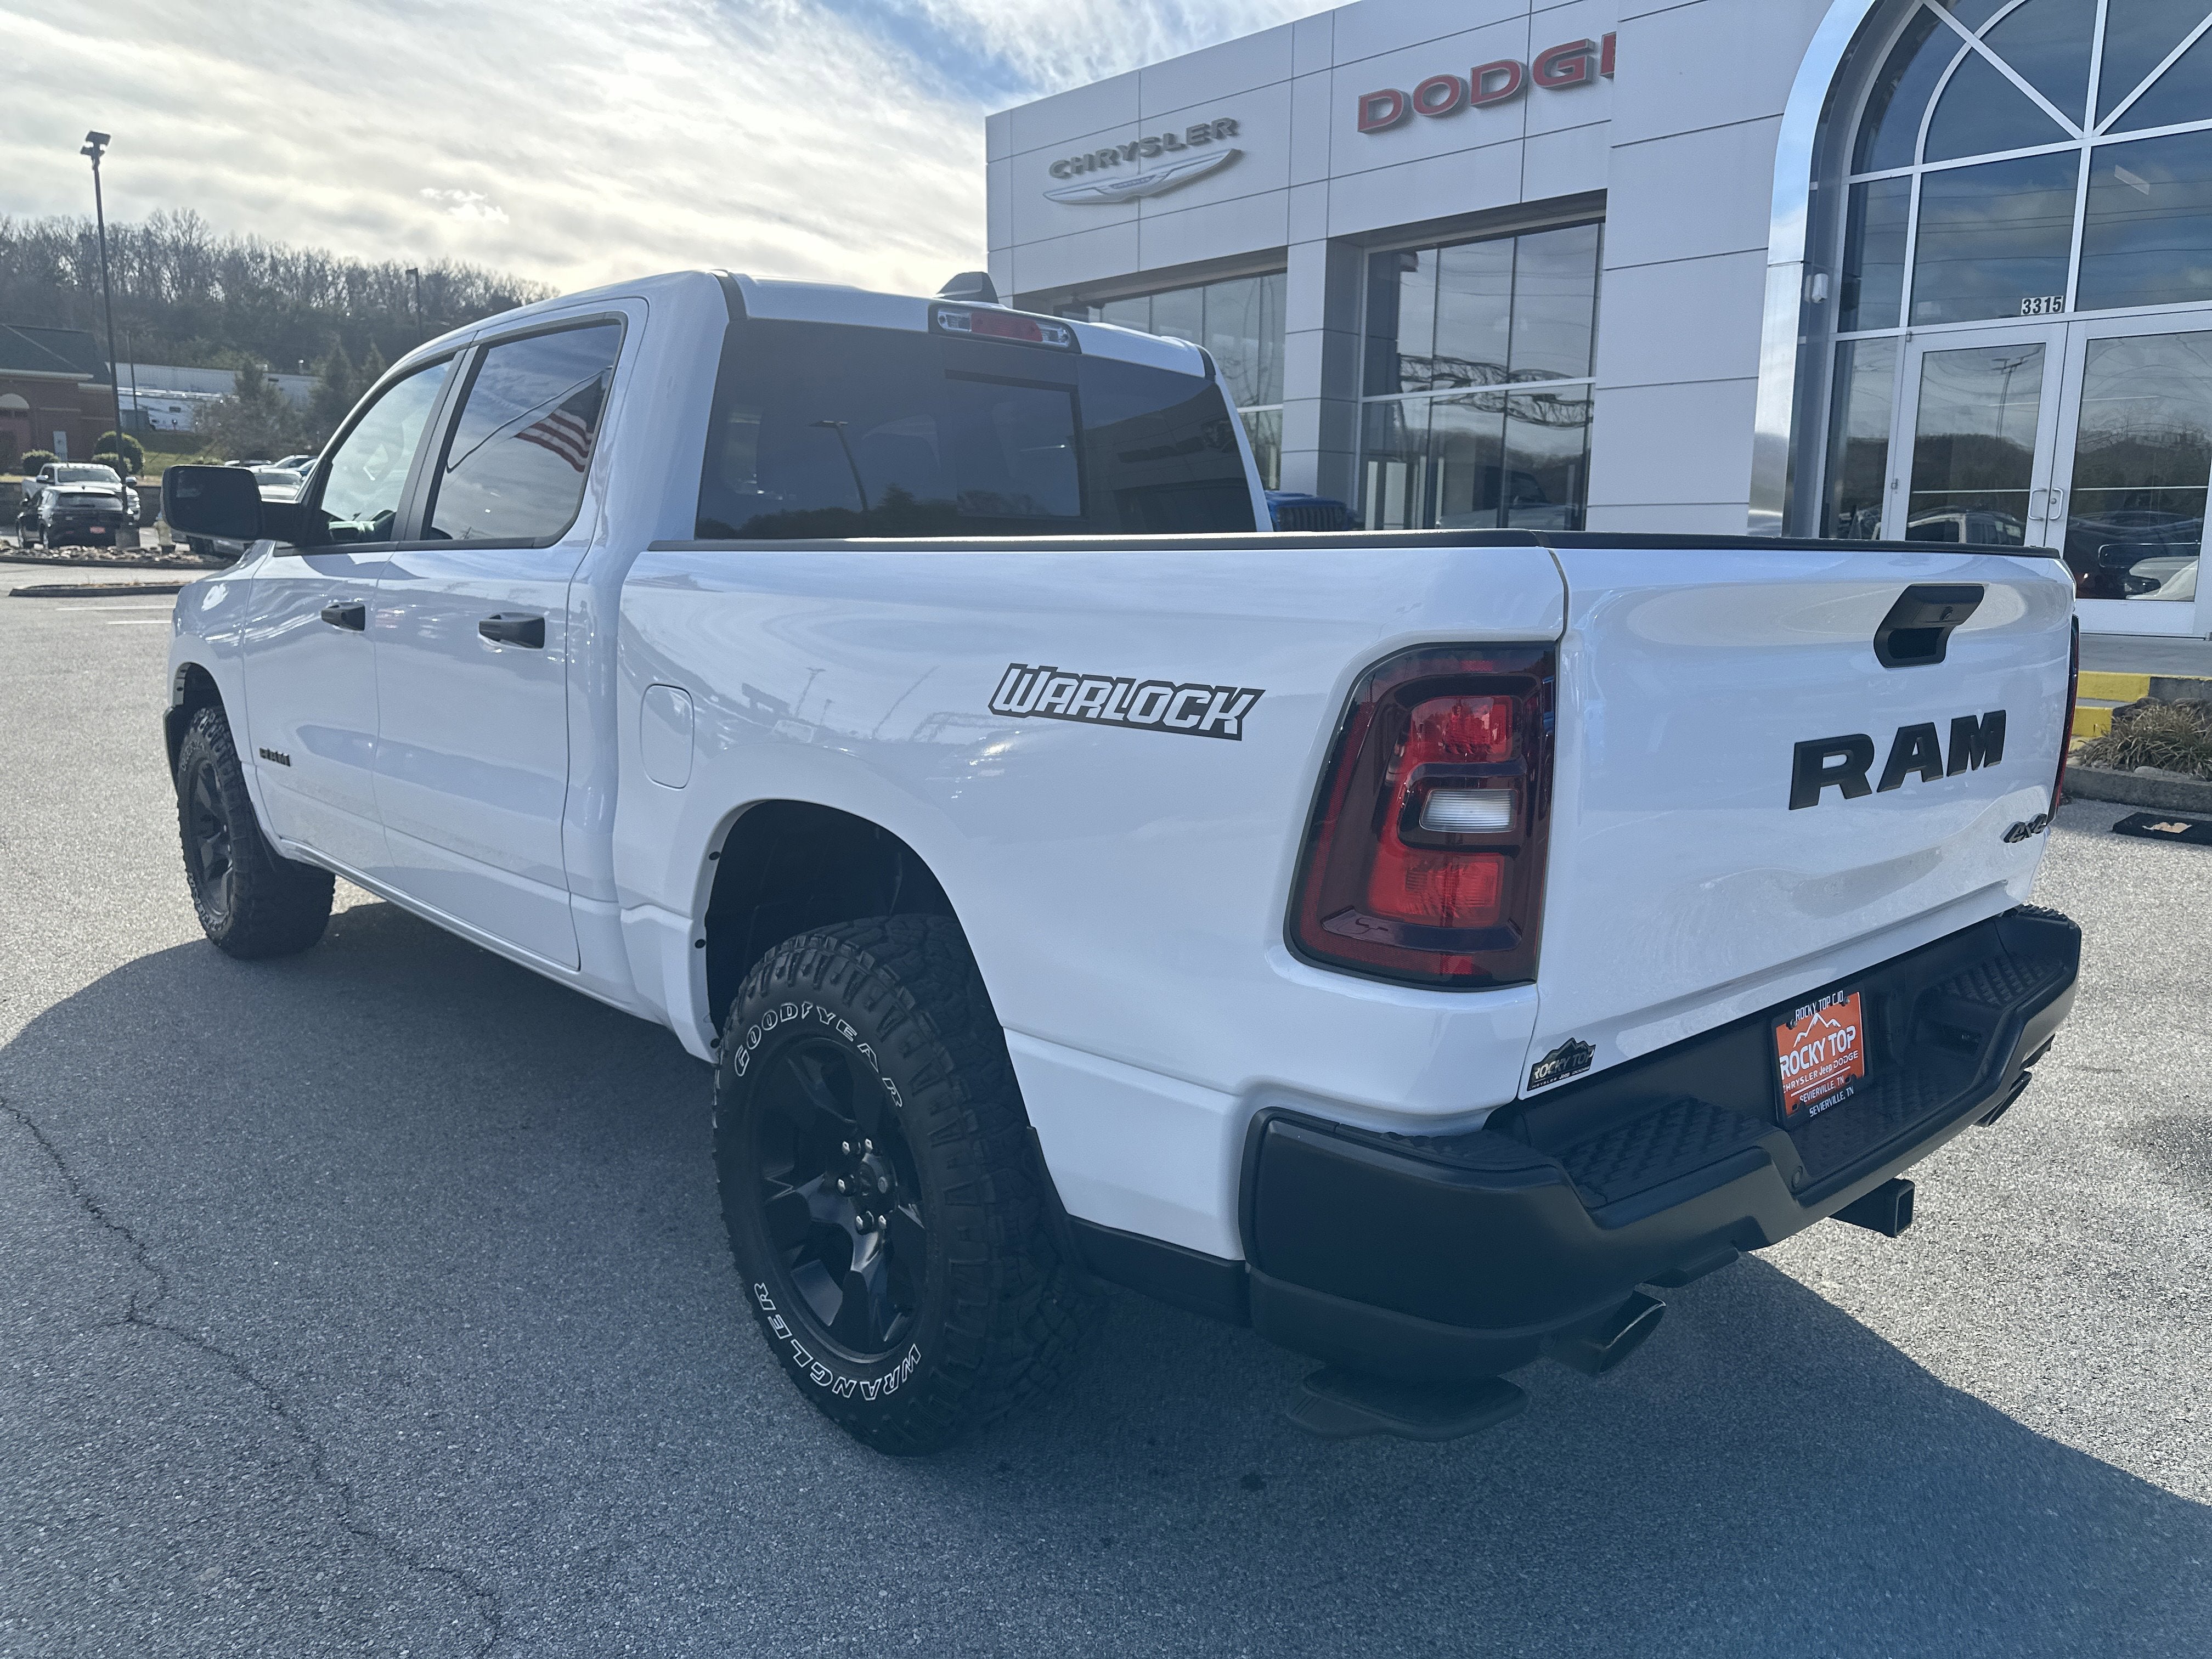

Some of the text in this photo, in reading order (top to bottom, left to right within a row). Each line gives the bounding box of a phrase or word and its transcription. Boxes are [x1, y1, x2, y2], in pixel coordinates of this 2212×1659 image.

[1048, 117, 1239, 179] CHRYSLER
[2022, 296, 2062, 315] 3315
[988, 663, 1266, 741] WARLOCK
[1789, 709, 2006, 810] RAM
[1795, 990, 1844, 1022] ROCKY TOP CJD
[734, 1001, 903, 1108] GOODYEAR
[1779, 1025, 1856, 1080] ROCKY TOP
[1819, 1064, 1832, 1076] Jeep
[1833, 1050, 1859, 1069] DODGE
[1799, 1075, 1844, 1103] SEVIERVILLE, TN
[1809, 1086, 1854, 1118] SEVIERVILLE, TN
[754, 1282, 922, 1401] WRANGLER
